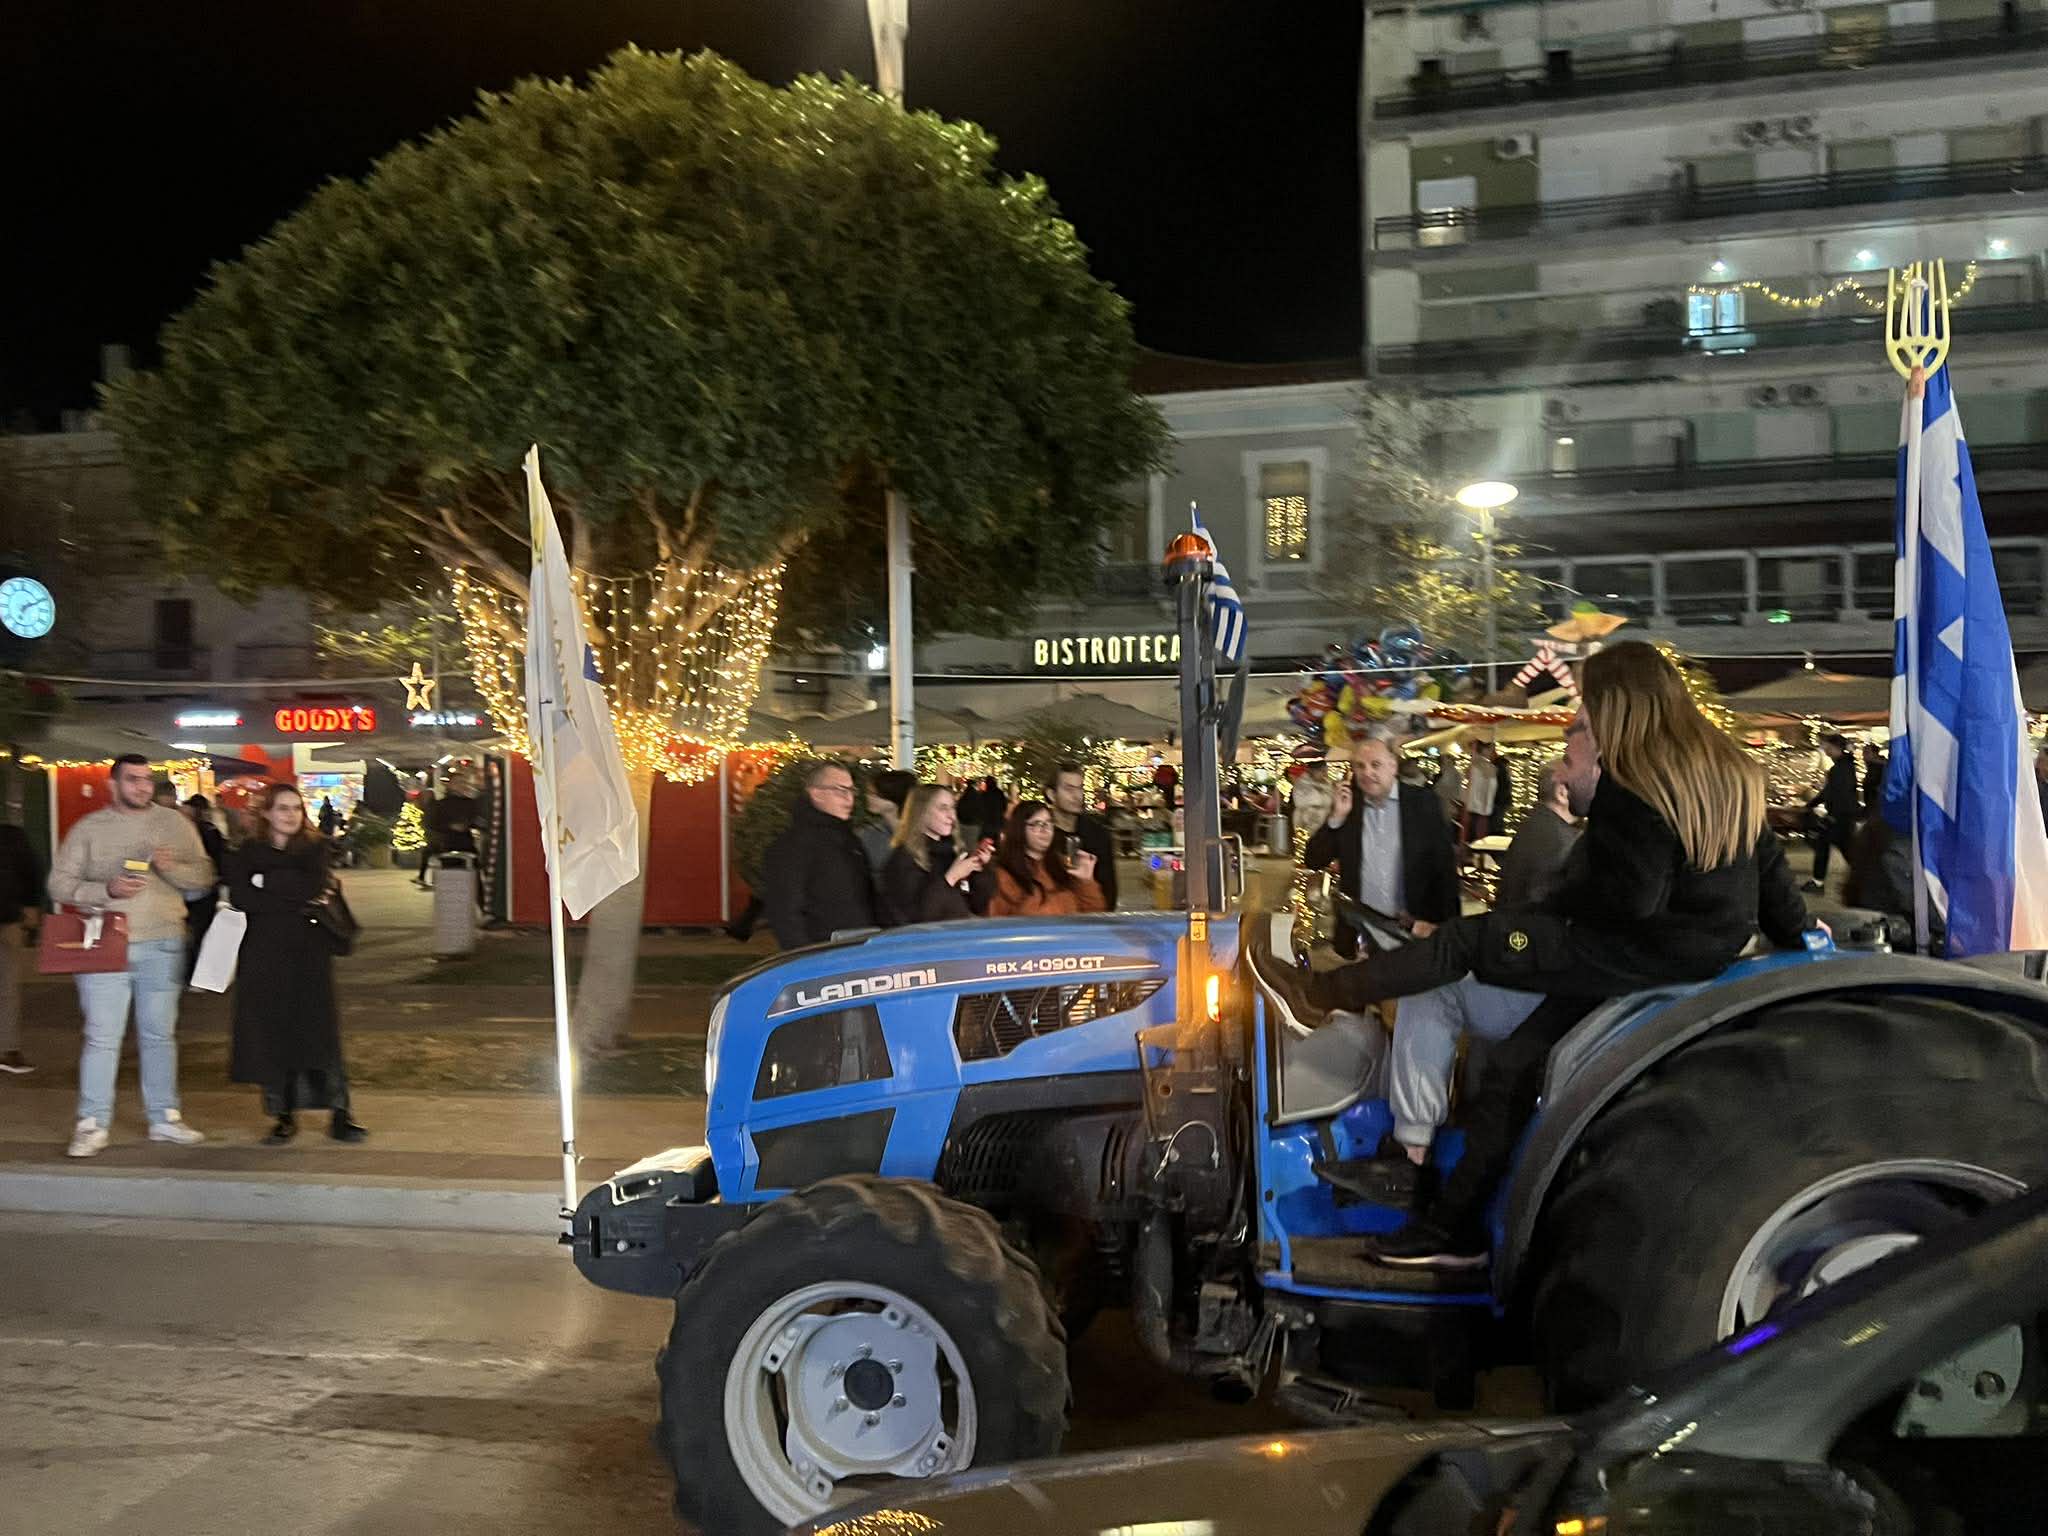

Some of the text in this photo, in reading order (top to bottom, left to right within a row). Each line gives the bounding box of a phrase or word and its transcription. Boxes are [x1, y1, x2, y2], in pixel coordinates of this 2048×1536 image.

[1034, 634, 1181, 666] BISTROTECA
[275, 705, 376, 732] GOODY'S
[986, 961, 1018, 974] REX
[1080, 956, 1105, 969] GT
[796, 968, 937, 1007] LANDINI
